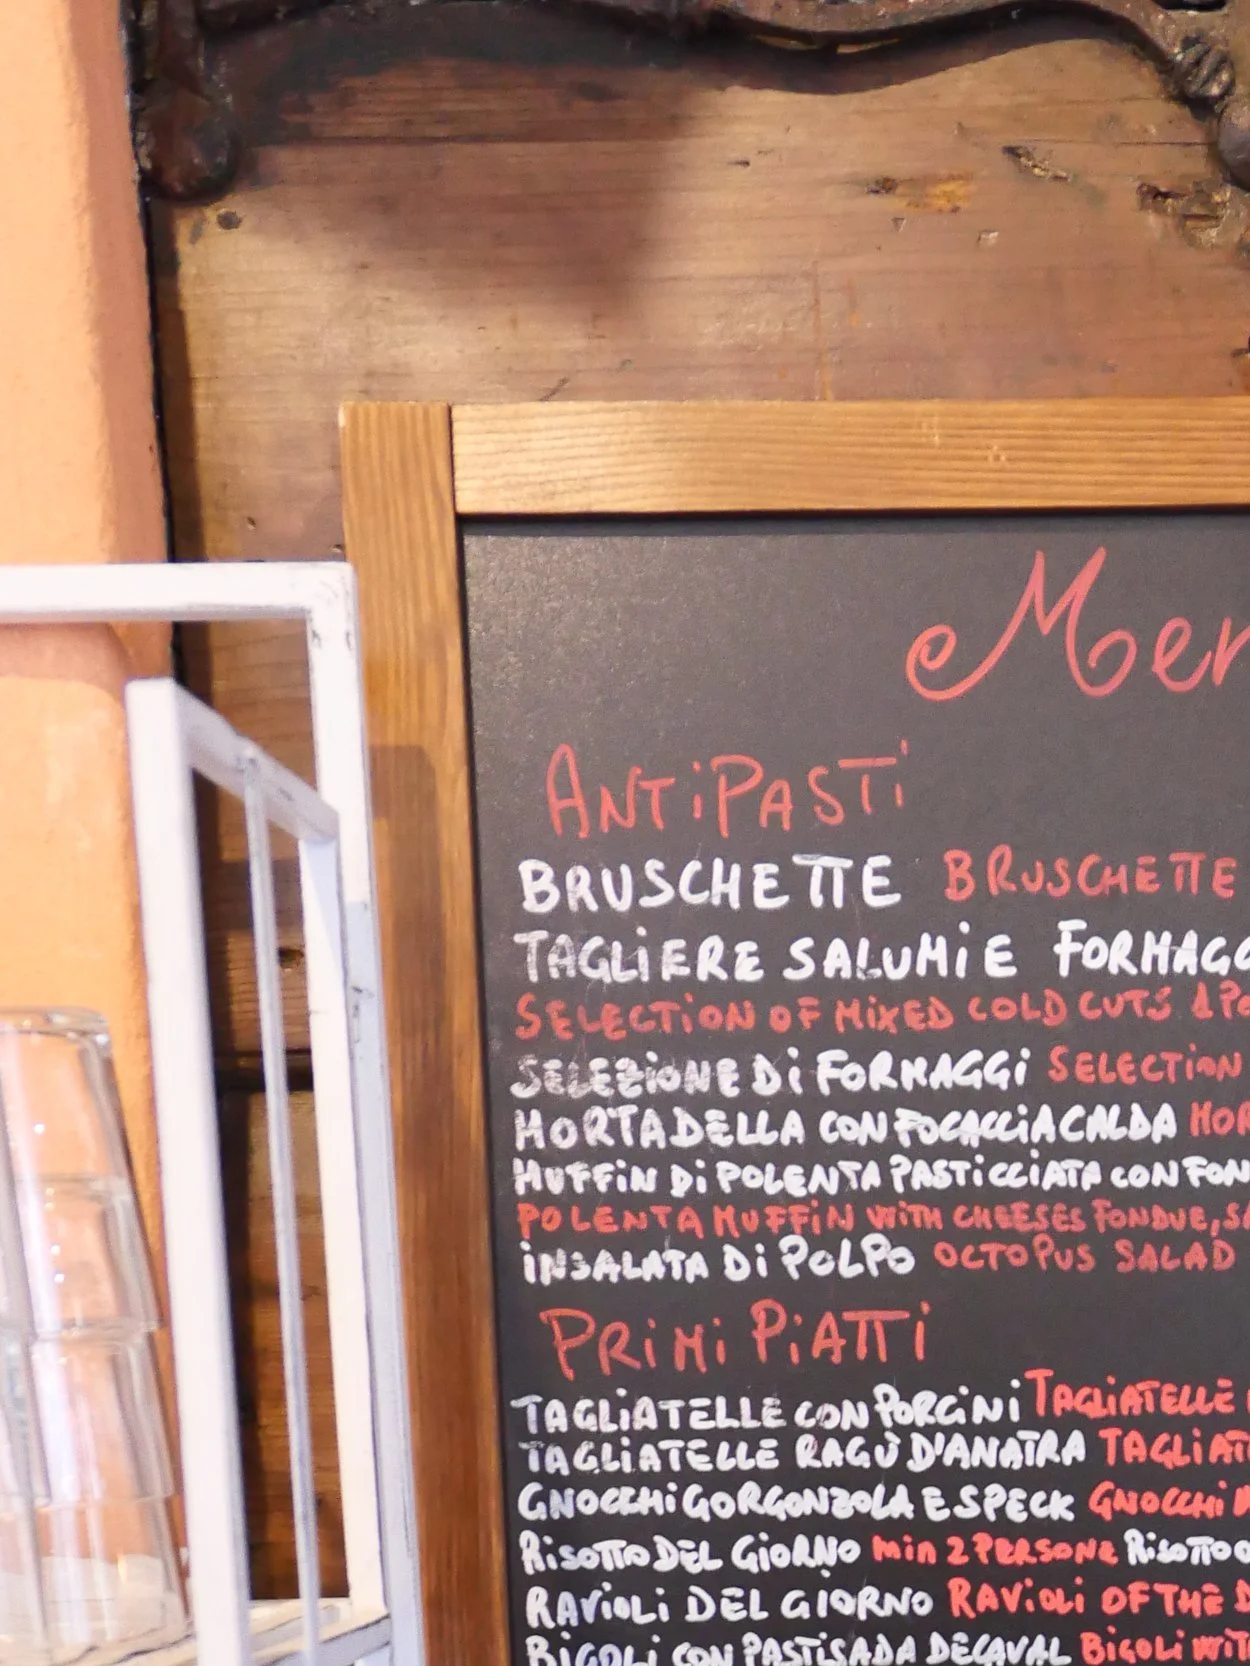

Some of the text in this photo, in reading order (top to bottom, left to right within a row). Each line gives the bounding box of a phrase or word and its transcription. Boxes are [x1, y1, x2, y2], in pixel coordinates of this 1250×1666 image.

[517, 844, 1238, 916] BRUSCHETTE BRUSCHETTE
[768, 996, 821, 1034] OF
[967, 987, 1068, 1028] COLD
[1078, 985, 1173, 1023] CUTS
[514, 1103, 806, 1152] MORTADELLA
[818, 1109, 889, 1147] CON
[715, 1159, 882, 1198] POLENTA
[1110, 1159, 1180, 1189] CON
[516, 1200, 1086, 1240] POLENTA CHEESES
[778, 1232, 1236, 1281] POLPO OCTOPUS SALAD
[793, 1399, 870, 1431] CON
[906, 1429, 1086, 1473] D'ANATRA
[681, 1480, 915, 1523] GORGONZOLA
[952, 1482, 1075, 1523] SPECK
[652, 1534, 724, 1575] DEL
[971, 1531, 1120, 1567] PERSONE
[684, 1585, 769, 1623] DEL
[1100, 1579, 1151, 1617] OF
[1160, 1582, 1225, 1619] THE
